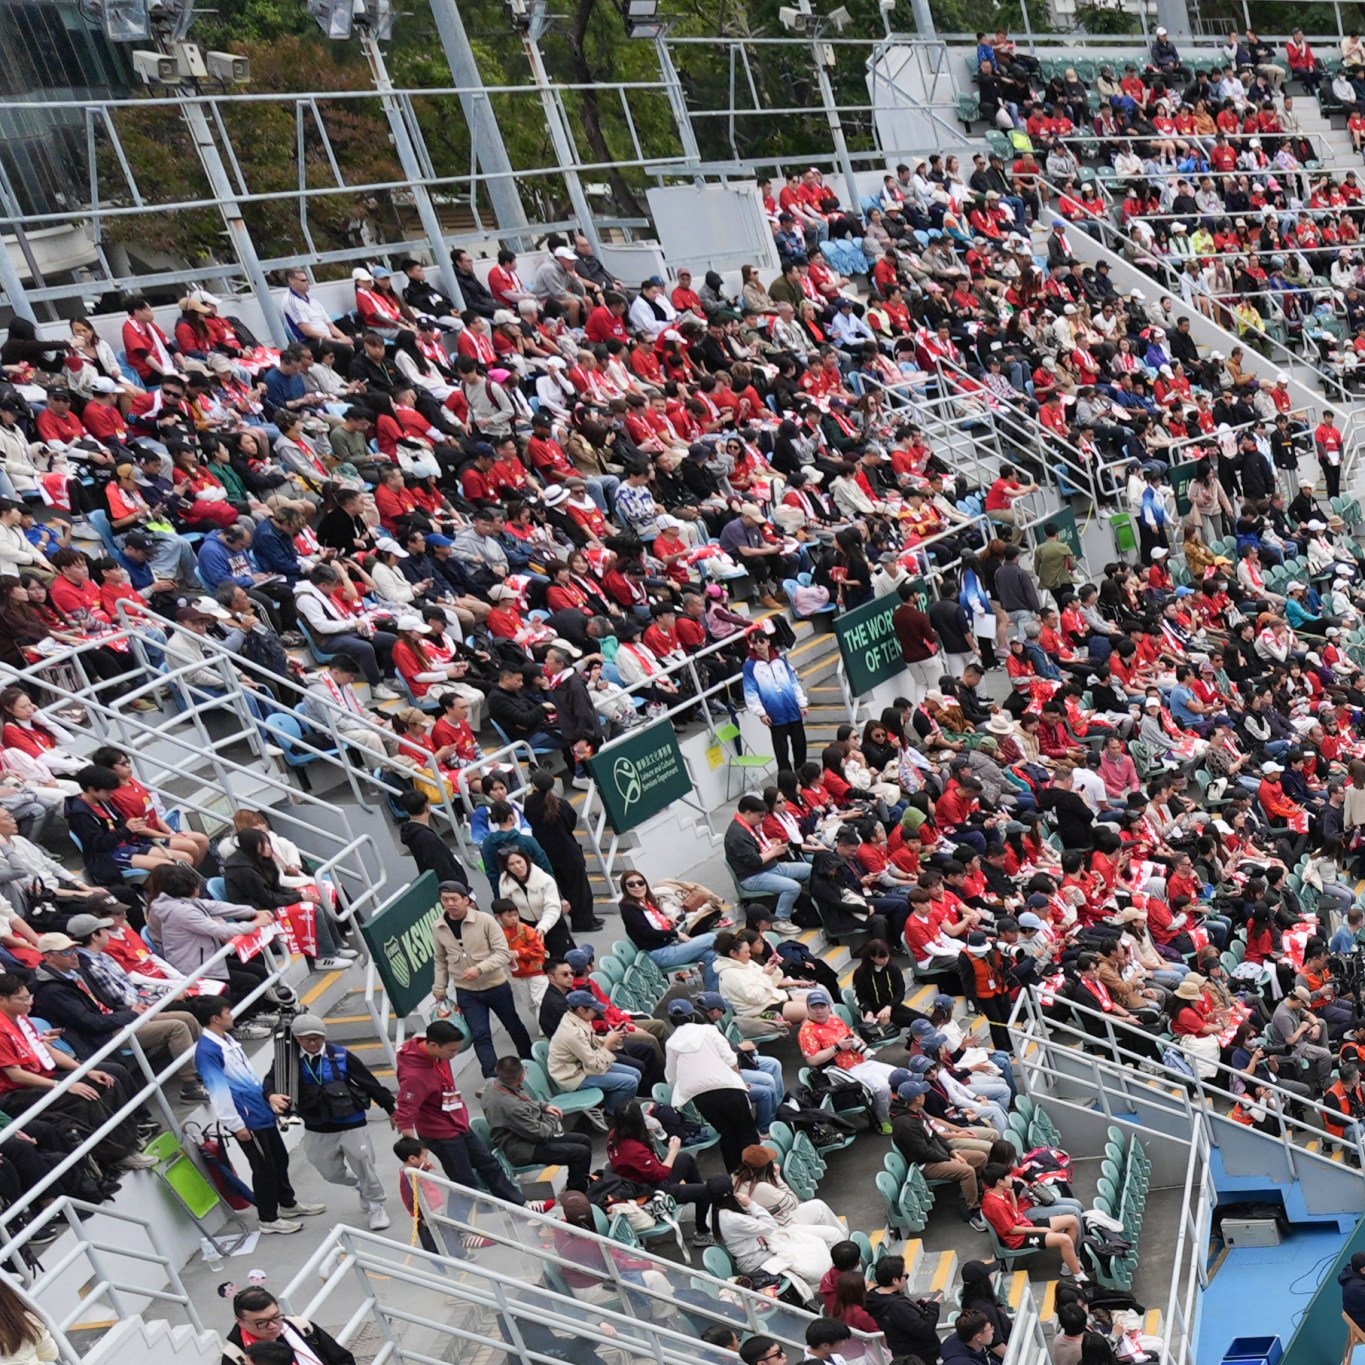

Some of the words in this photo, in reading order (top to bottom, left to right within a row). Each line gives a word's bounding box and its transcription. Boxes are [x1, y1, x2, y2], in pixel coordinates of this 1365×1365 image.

[843, 623, 869, 653] THE
[866, 606, 898, 641] WOR
[865, 647, 881, 673] OF
[881, 637, 903, 663] TEN
[641, 768, 655, 781] Leisure
[661, 756, 676, 770] Cultural
[642, 779, 658, 792] Services
[658, 765, 679, 783] Department
